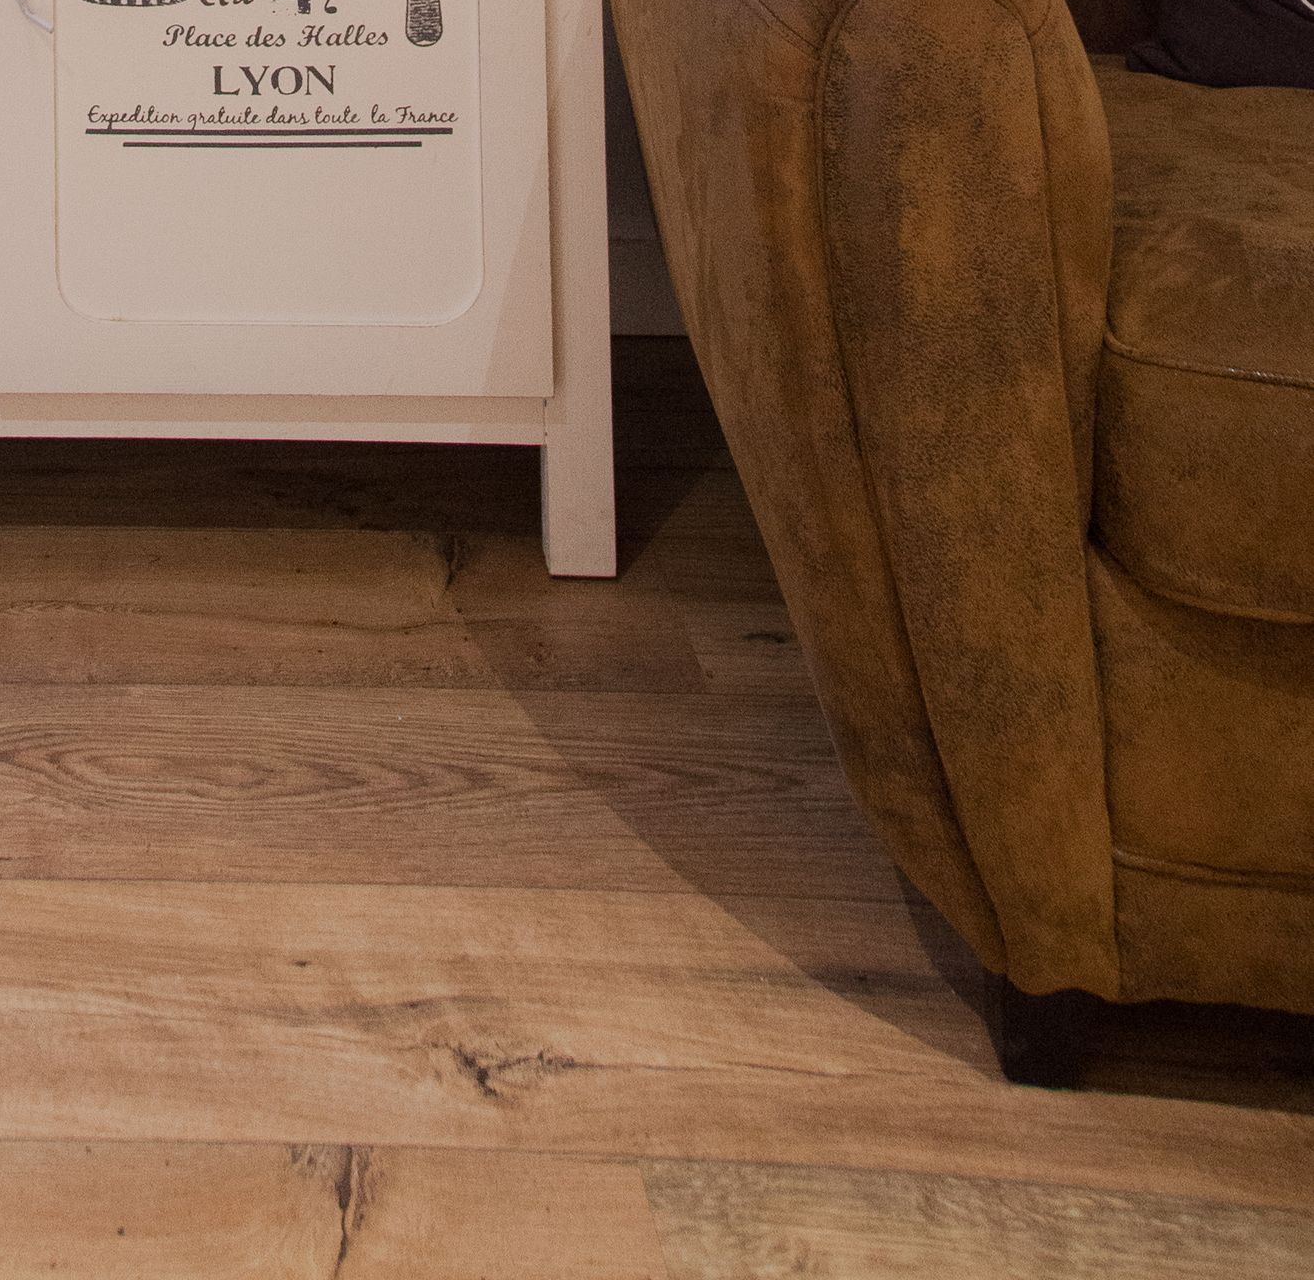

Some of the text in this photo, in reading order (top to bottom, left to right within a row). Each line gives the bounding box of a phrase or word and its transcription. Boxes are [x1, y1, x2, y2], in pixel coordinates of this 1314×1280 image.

[163, 25, 388, 47] Place des Halles
[213, 65, 335, 95] LYON
[88, 104, 458, 128] Expedition gratuite dans toute la France
